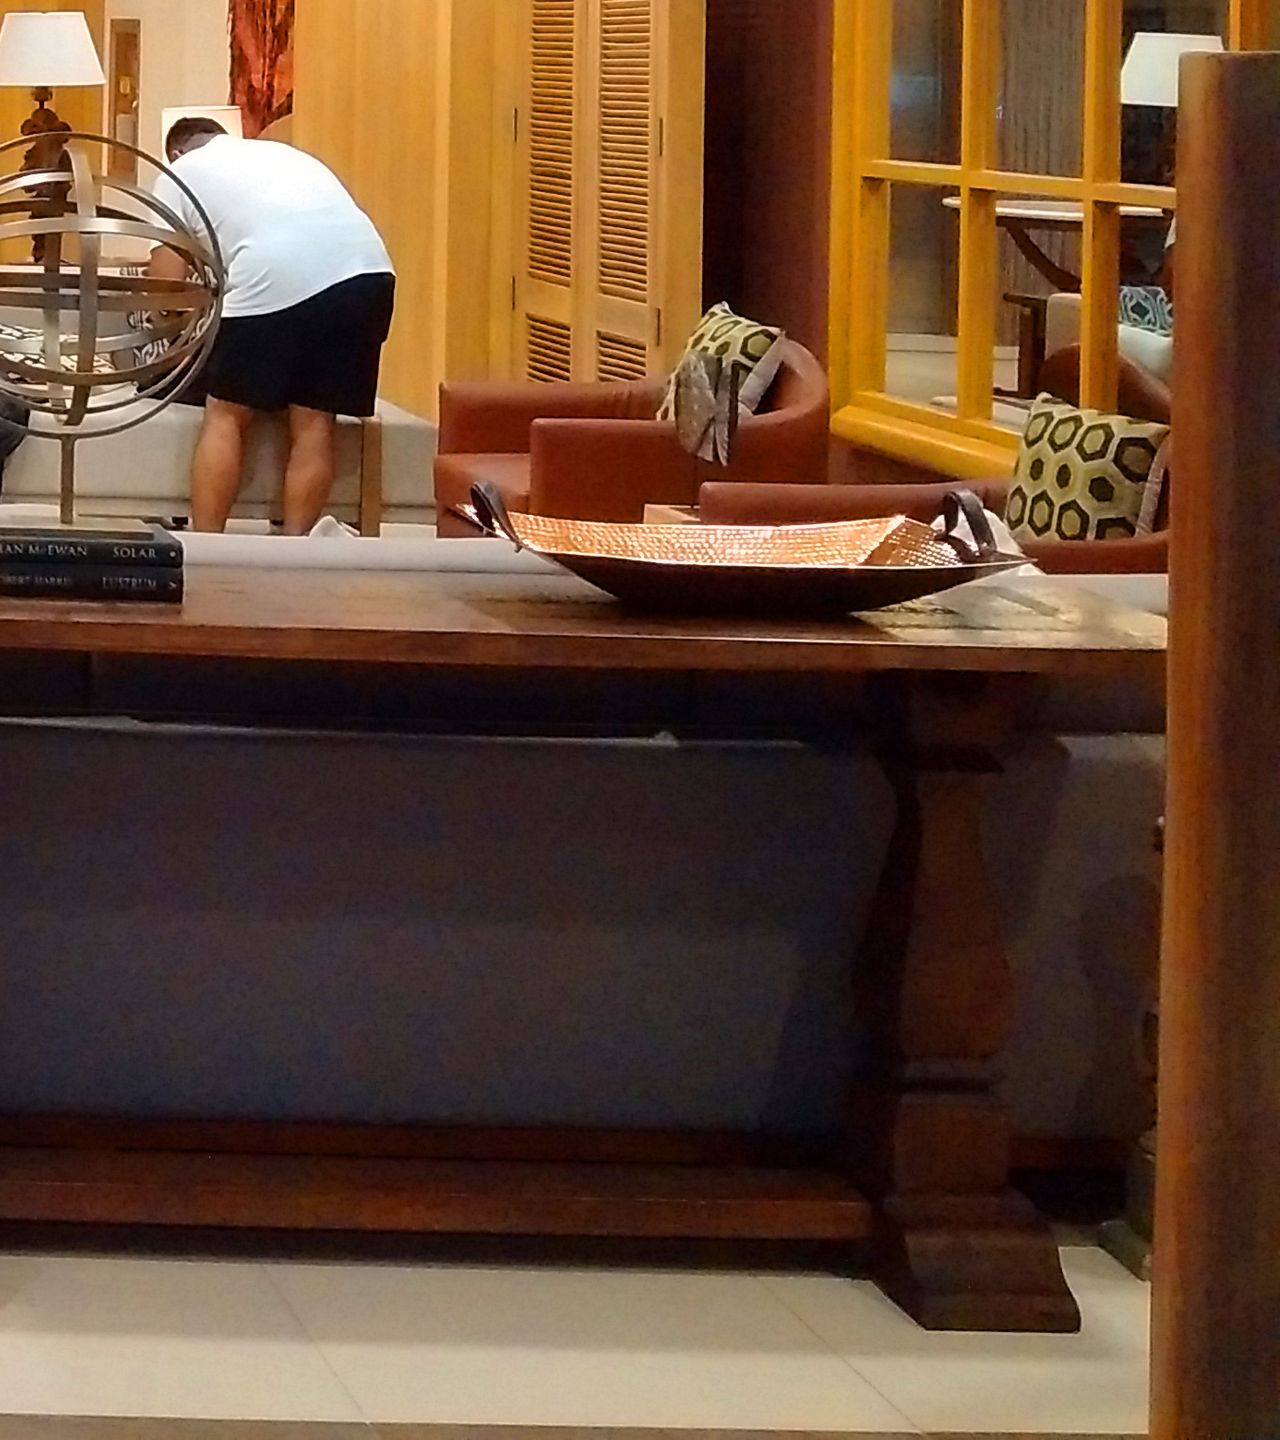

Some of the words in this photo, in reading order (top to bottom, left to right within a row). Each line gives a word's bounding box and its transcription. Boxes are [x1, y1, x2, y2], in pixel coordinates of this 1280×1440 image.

[0, 543, 24, 555] IAN
[28, 544, 88, 557] MEWAN
[113, 547, 157, 559] SOLAR
